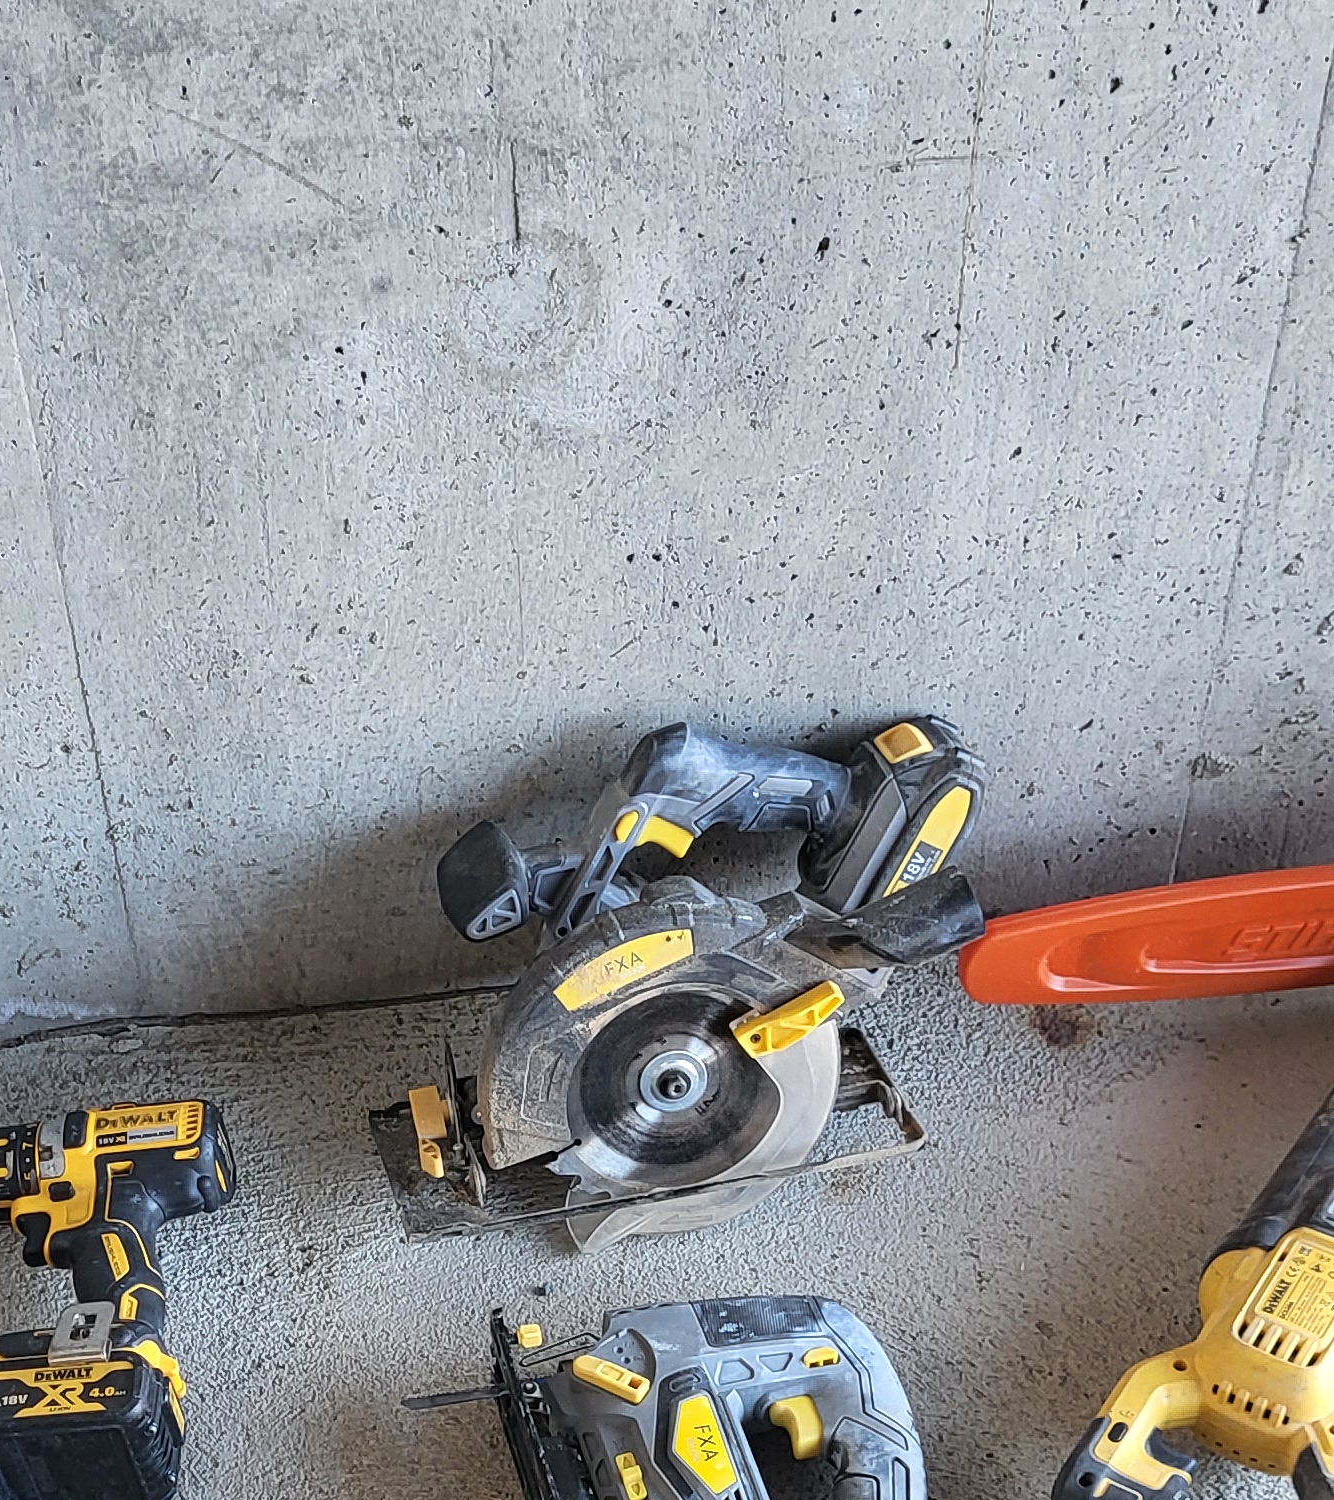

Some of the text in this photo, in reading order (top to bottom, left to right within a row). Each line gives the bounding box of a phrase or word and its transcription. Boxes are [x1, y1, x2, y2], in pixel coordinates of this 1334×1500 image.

[903, 852, 925, 880] 18V
[604, 951, 644, 975] FXA
[1, 1394, 29, 1406] 18V
[40, 1383, 84, 1406] XR
[693, 1425, 719, 1461] FXA
